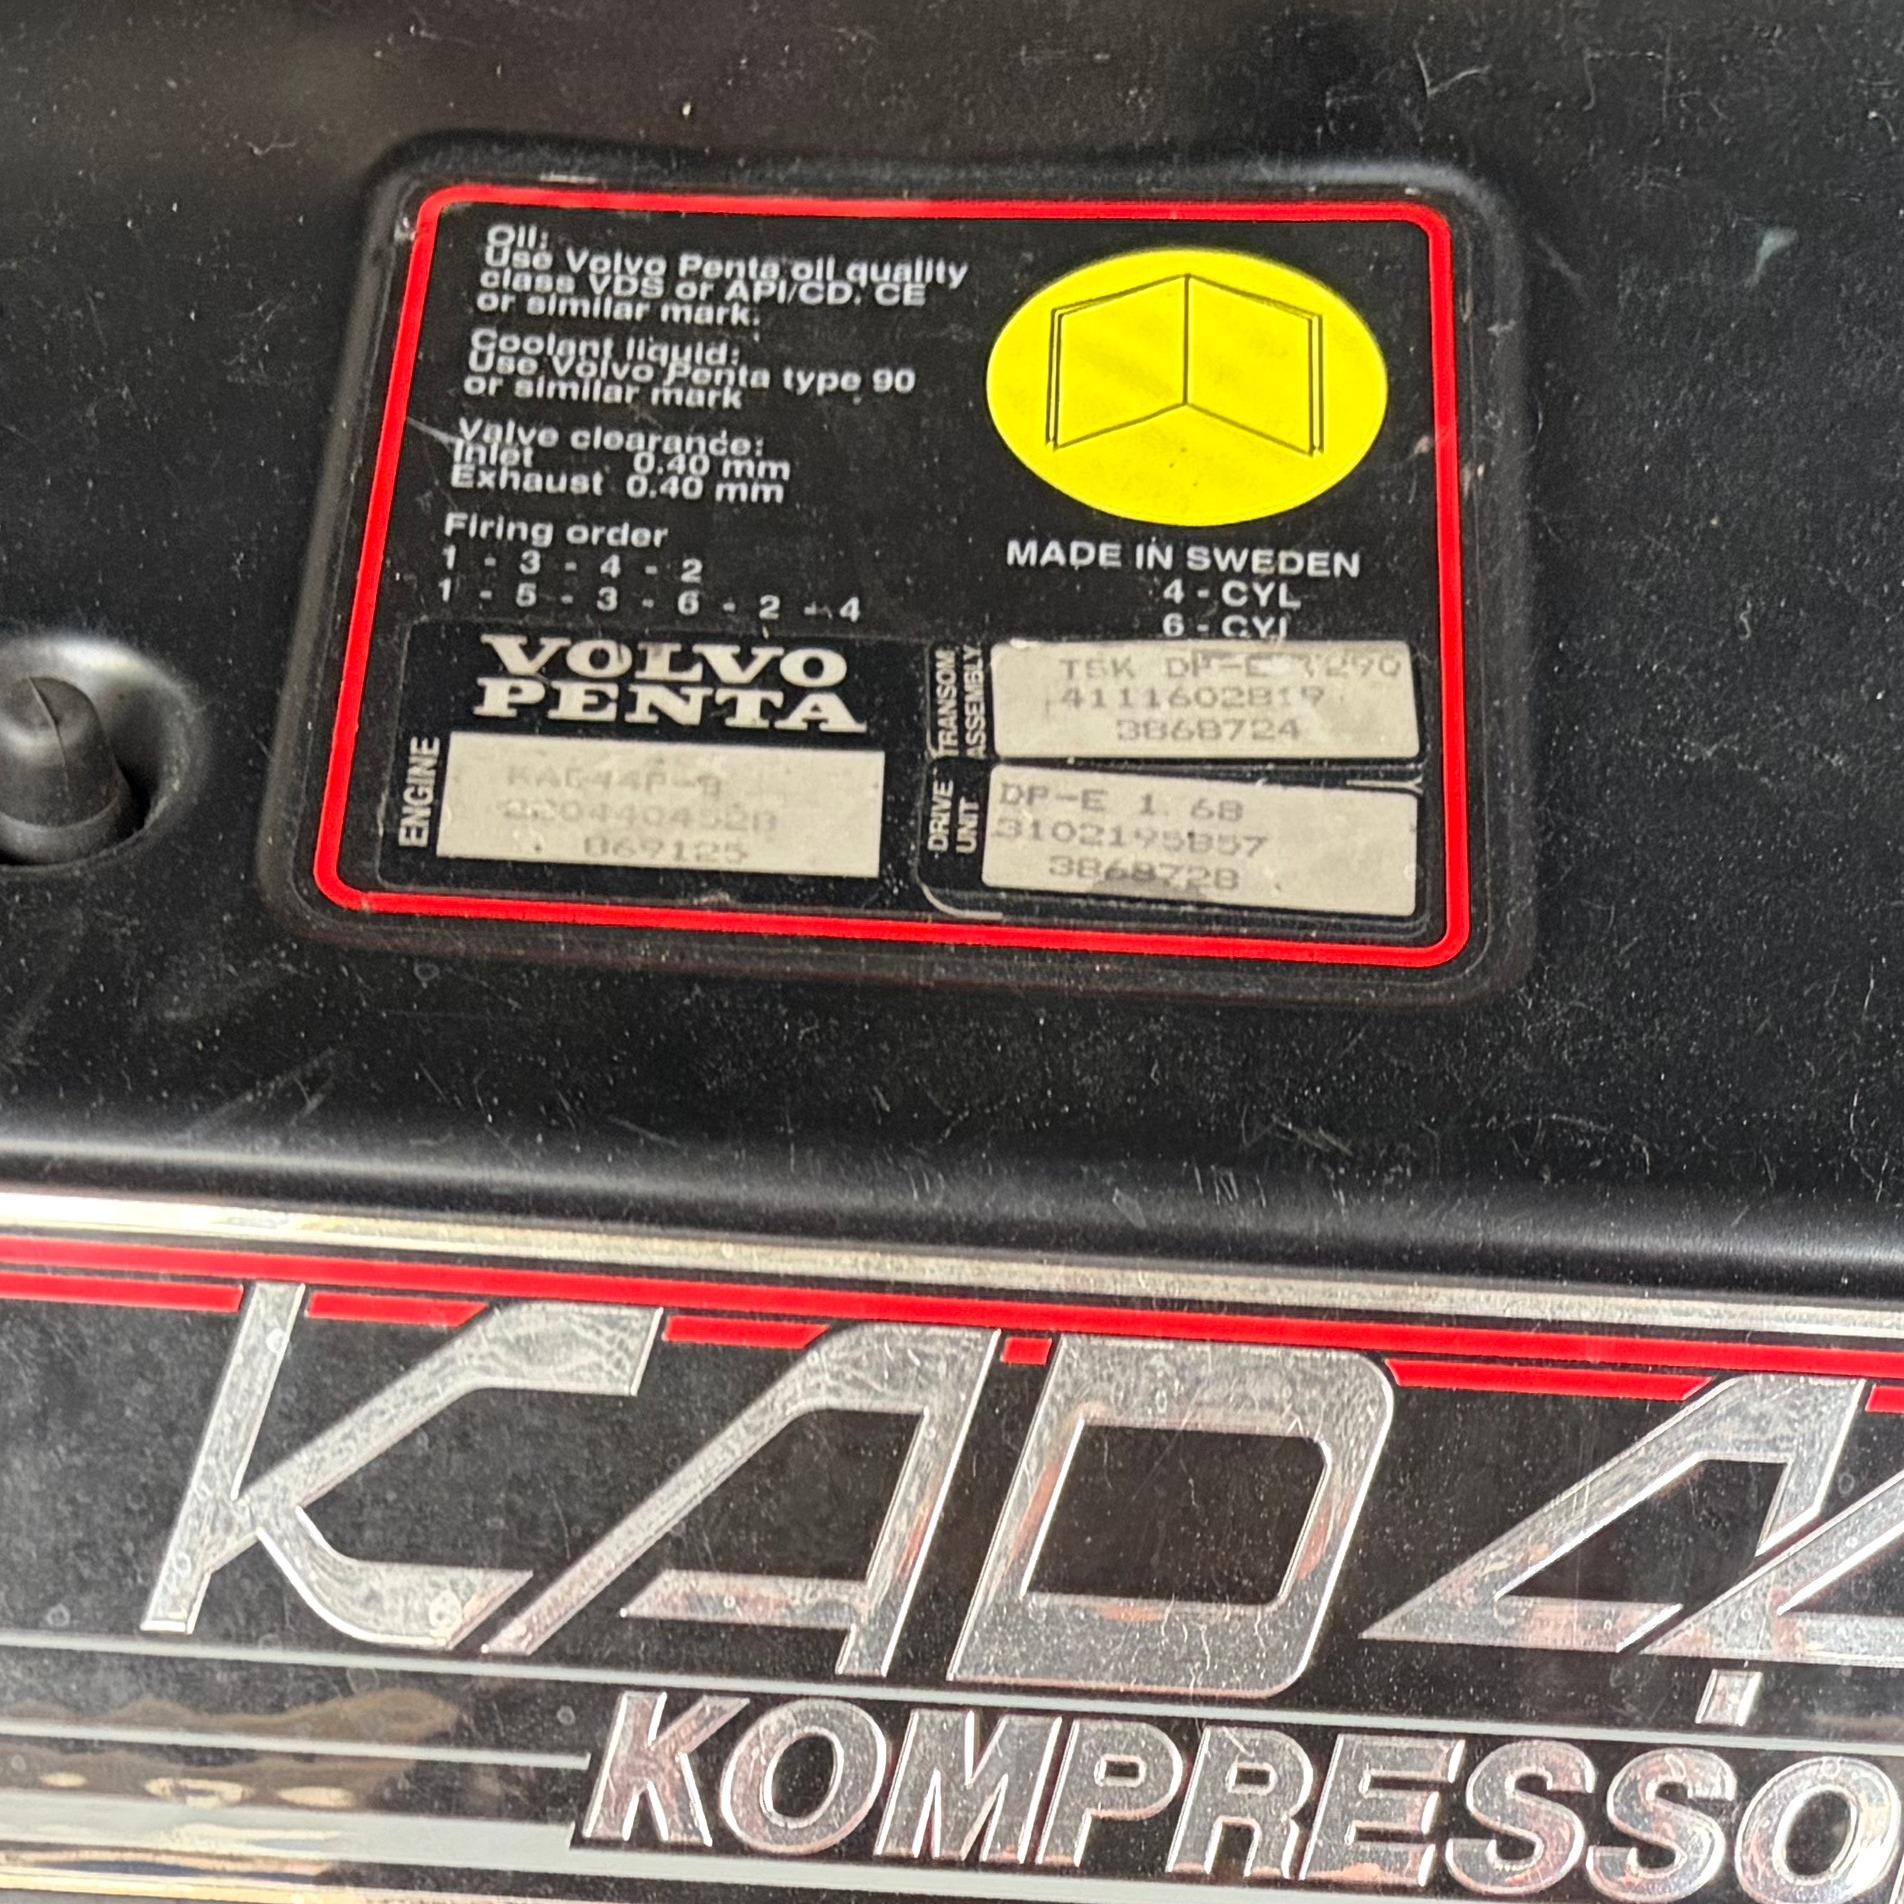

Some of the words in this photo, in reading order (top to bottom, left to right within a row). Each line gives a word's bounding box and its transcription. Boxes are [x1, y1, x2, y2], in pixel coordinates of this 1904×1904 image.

[487, 223, 548, 250] Oil:
[480, 268, 575, 293] class
[588, 274, 663, 299] VDS
[675, 281, 714, 301] or
[875, 283, 926, 306] CE
[485, 246, 553, 271] Use
[566, 247, 667, 275] Volvo
[679, 253, 780, 280] Penta
[791, 255, 835, 281] oil
[846, 255, 969, 290] quality
[476, 292, 516, 313] or
[527, 292, 650, 321] similar
[471, 328, 614, 358] Coolant
[627, 336, 740, 368] liquid:
[464, 375, 503, 396] or
[514, 375, 639, 404] similar
[651, 385, 742, 410] mark
[469, 350, 538, 375] Use
[552, 355, 654, 382] Volvo
[665, 360, 771, 389] Penta
[783, 366, 861, 396] type
[871, 367, 916, 394] 90
[459, 417, 559, 448] Valve
[570, 425, 764, 458] clearance:
[453, 438, 533, 468] Inlet
[633, 451, 710, 477] 0.40
[722, 458, 790, 481] mm
[451, 463, 603, 496] Exhaust
[626, 474, 703, 500] 0.40
[715, 480, 784, 504] mm
[445, 511, 553, 548] Firing
[566, 521, 669, 547] order
[442, 544, 457, 570] 1
[519, 549, 541, 575] 3
[599, 553, 621, 578] 4
[681, 557, 703, 583] 2
[1006, 539, 1122, 568] MADE
[1135, 543, 1173, 570] IN
[1186, 545, 1360, 578] SWEDEN
[438, 577, 452, 602] 1
[515, 582, 537, 608] 5
[596, 586, 618, 611] 3
[677, 590, 699, 615] 6
[759, 594, 781, 620] 2
[839, 597, 861, 622] 4
[1162, 578, 1184, 604] 4
[1221, 581, 1302, 610] CYL
[1162, 613, 1184, 637] 6
[481, 634, 848, 687] VOLVO
[473, 678, 868, 733] PENTA
[935, 648, 958, 757] TRANSOM
[963, 644, 986, 759] ASSEMBLY
[1116, 718, 1300, 742] 3868724
[398, 736, 440, 848] ENGINE
[1000, 782, 1109, 812] DP-E
[928, 779, 954, 852] DRIVE
[956, 796, 980, 854] UNIT
